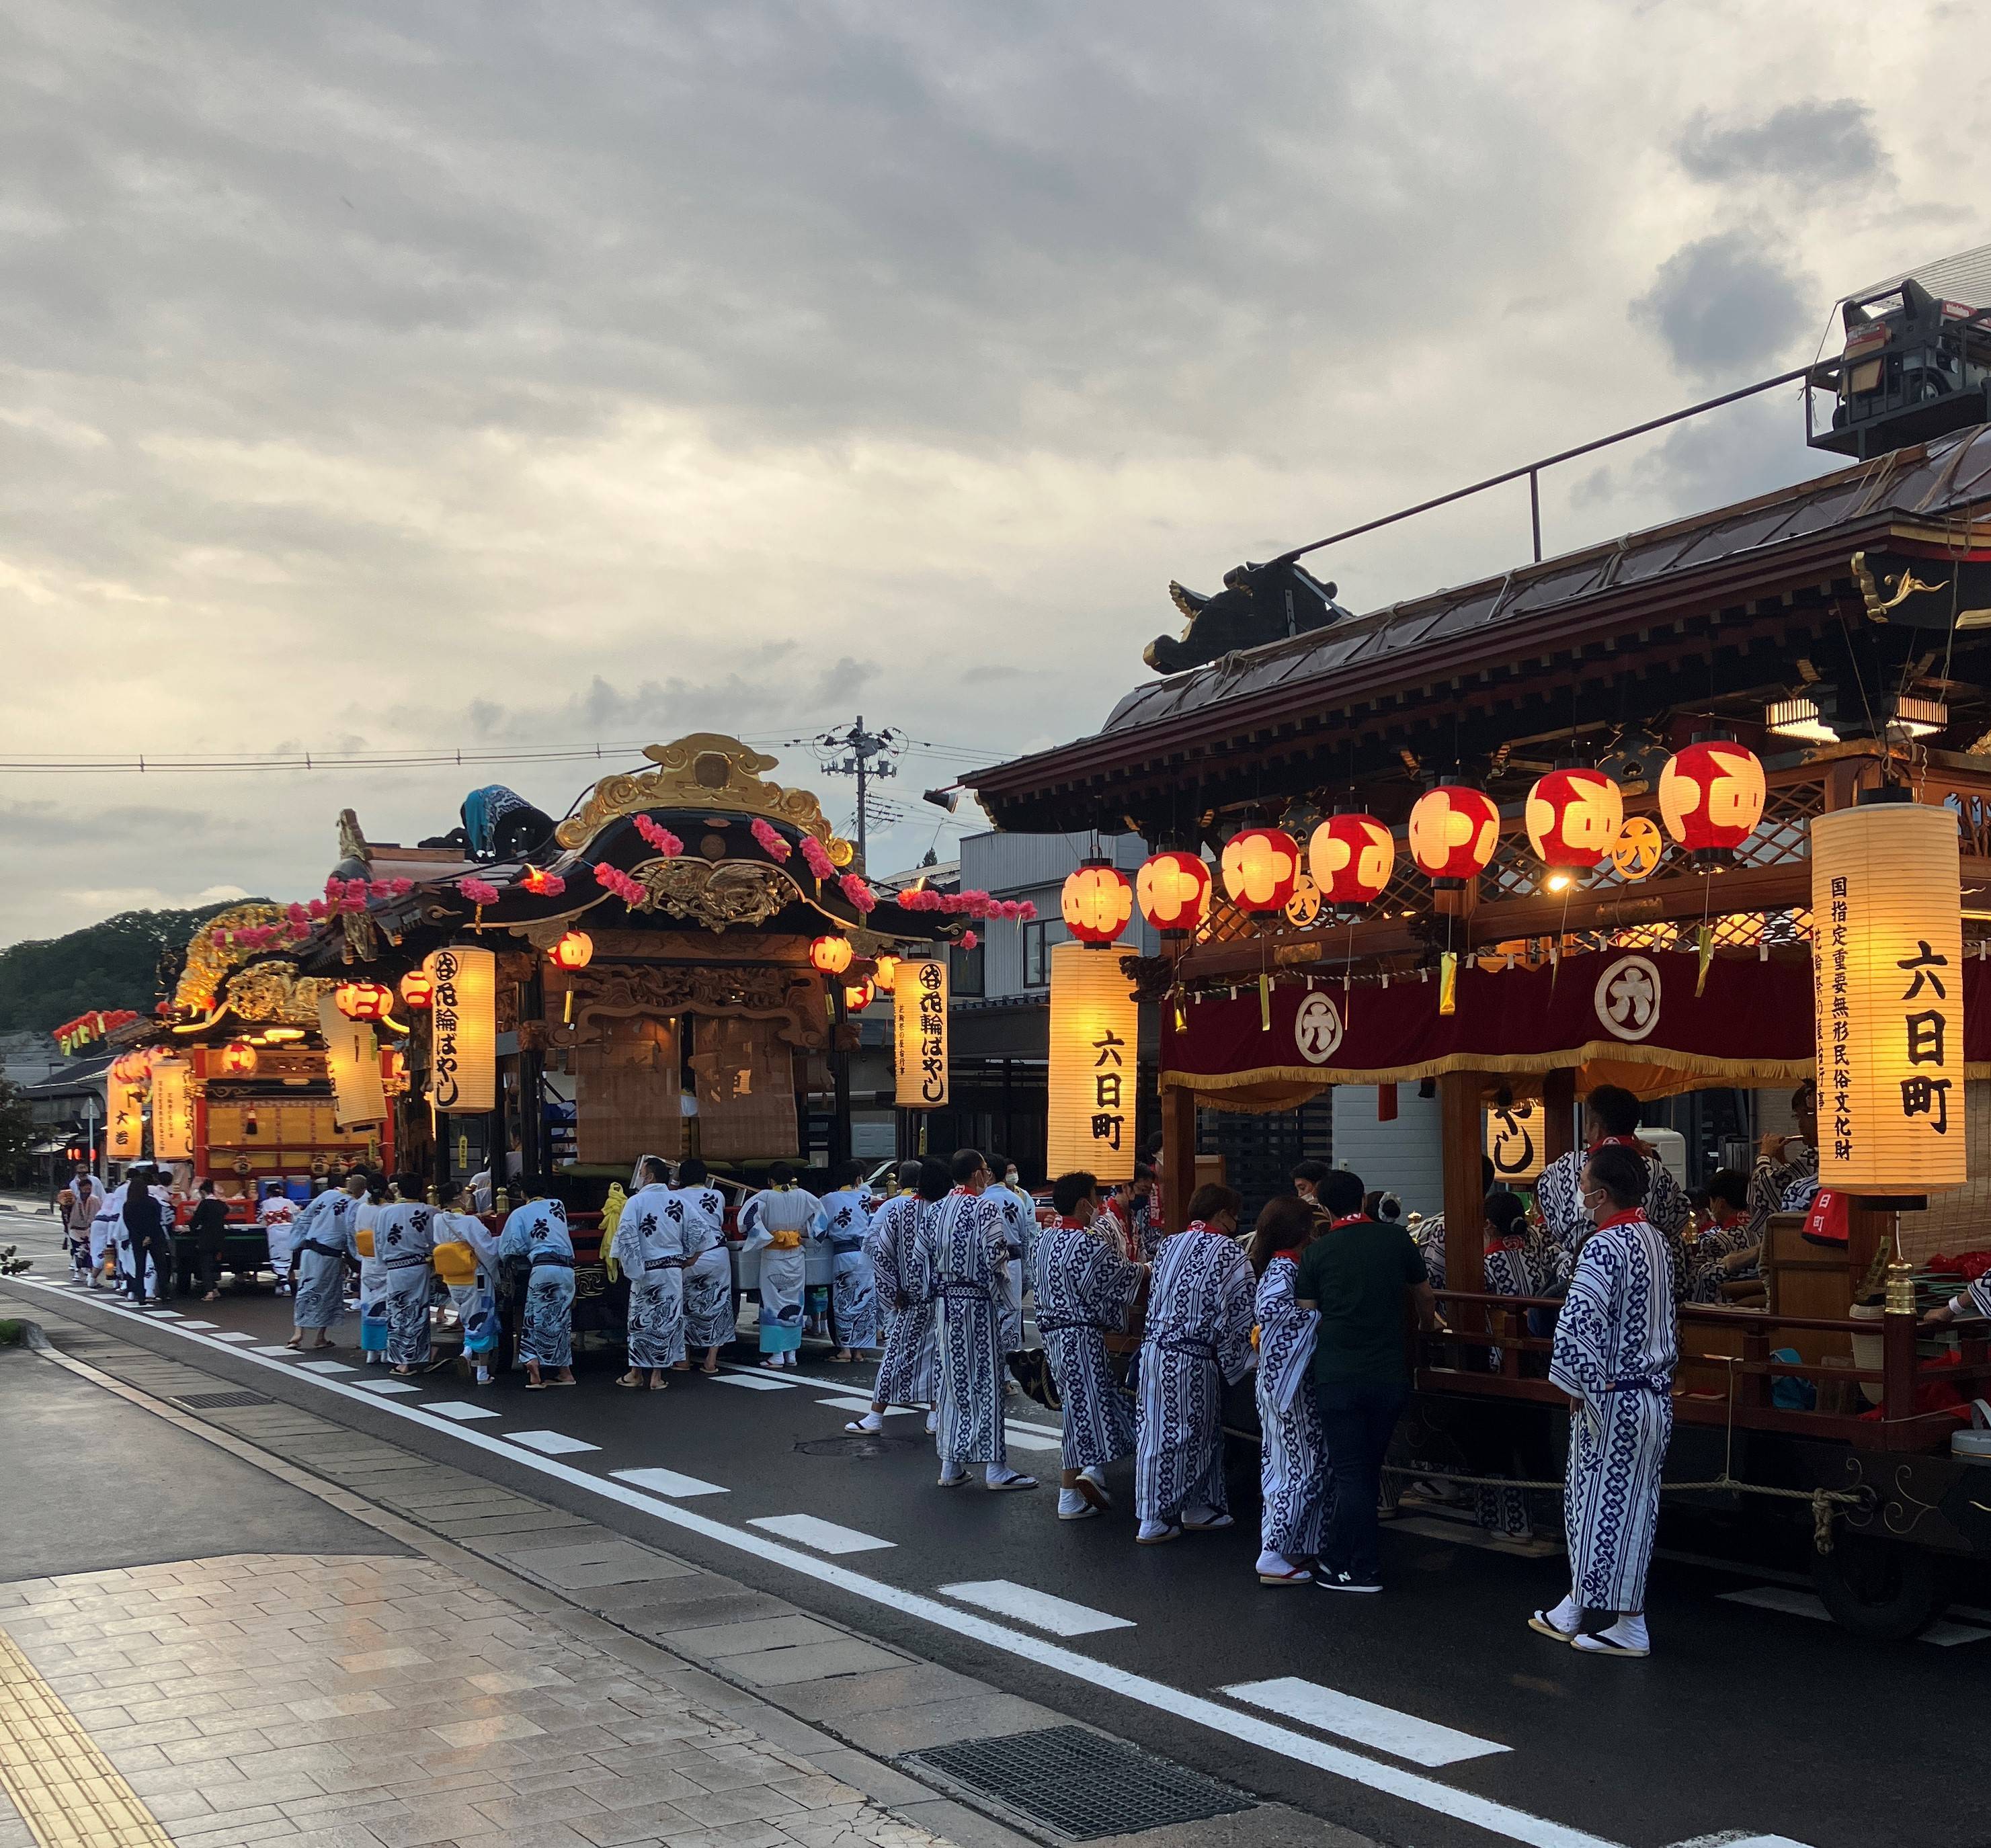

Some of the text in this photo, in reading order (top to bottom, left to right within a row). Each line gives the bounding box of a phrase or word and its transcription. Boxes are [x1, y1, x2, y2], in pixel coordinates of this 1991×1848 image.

[1091, 1029, 1125, 1151] 六日町
[1831, 876, 1853, 1161] 国指定重要無形民俗文化財
[1896, 939, 1952, 1136] 六日町
